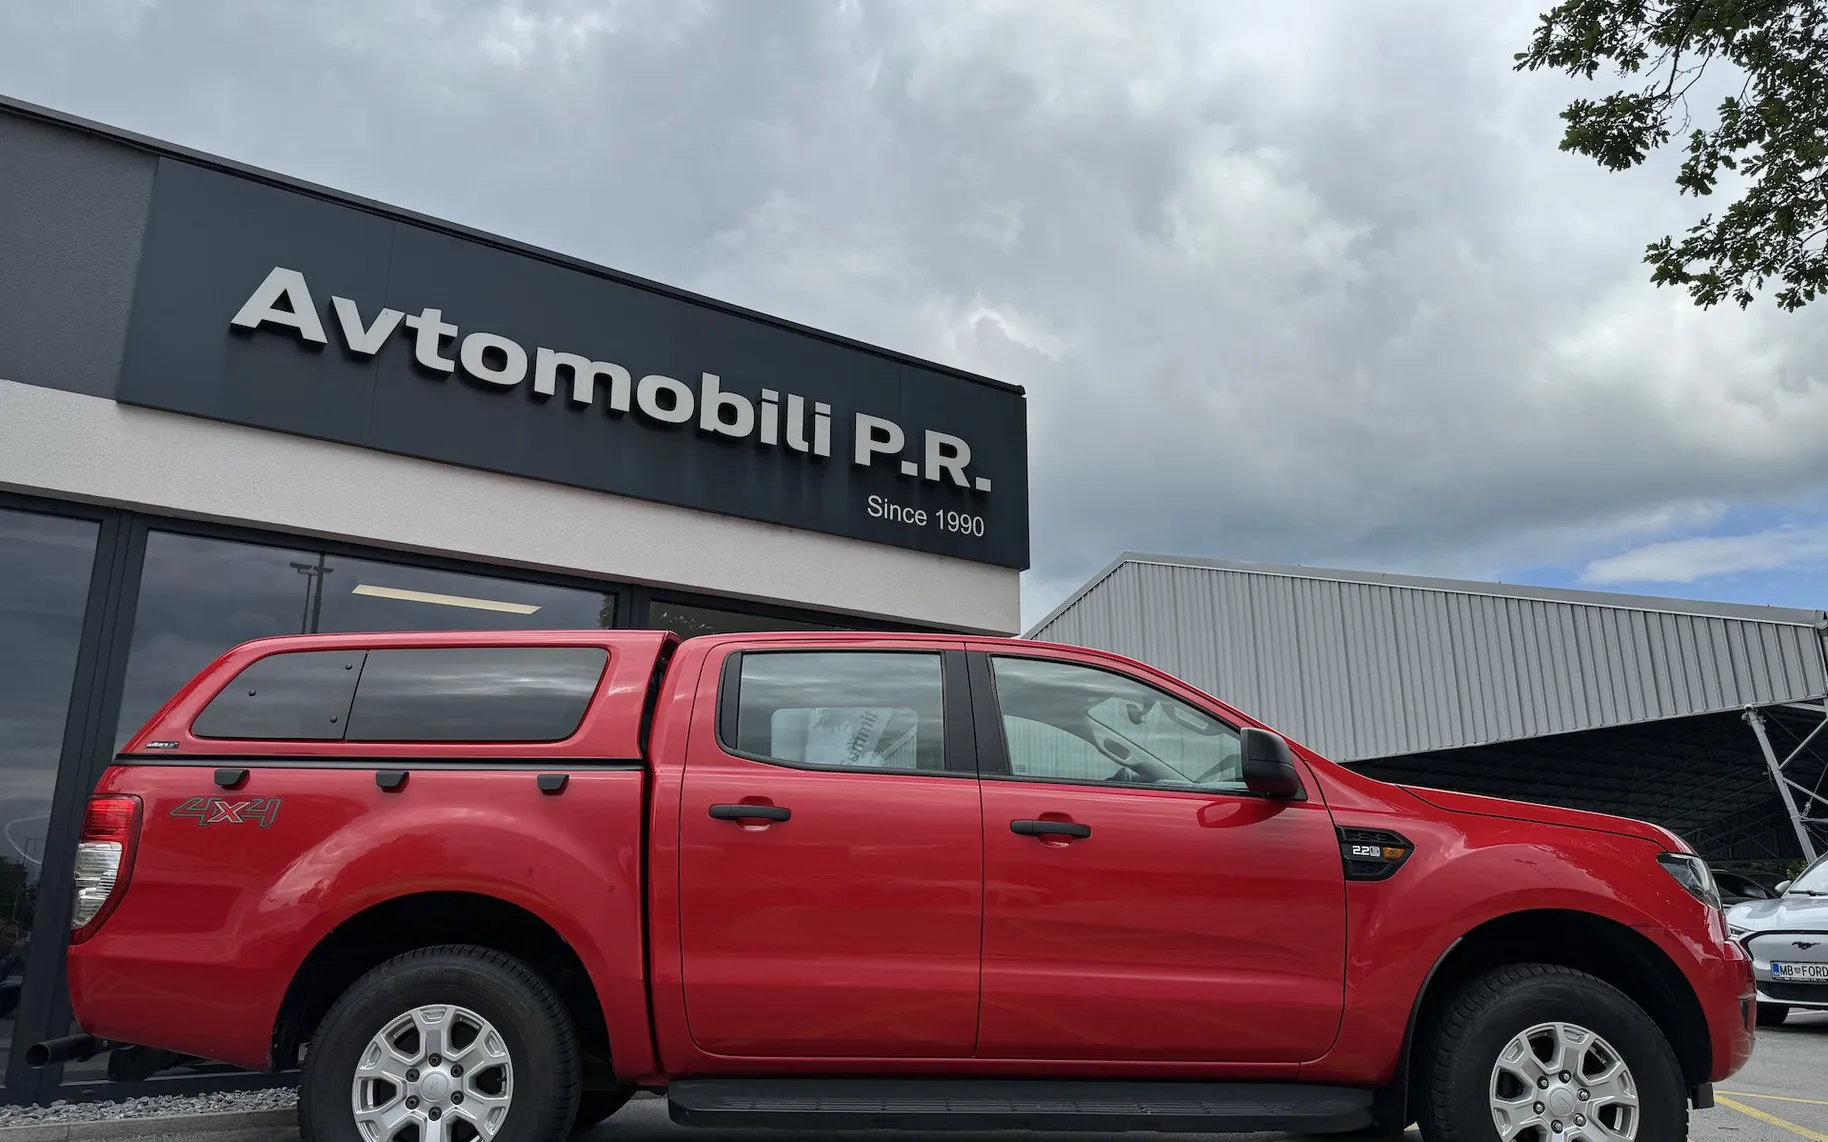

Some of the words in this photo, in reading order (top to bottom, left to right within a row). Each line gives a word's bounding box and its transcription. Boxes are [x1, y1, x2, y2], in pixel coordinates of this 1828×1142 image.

[230, 266, 831, 458] Avtomobili
[855, 412, 992, 492] P.R.
[867, 495, 928, 527] Since
[935, 509, 985, 537] 1990
